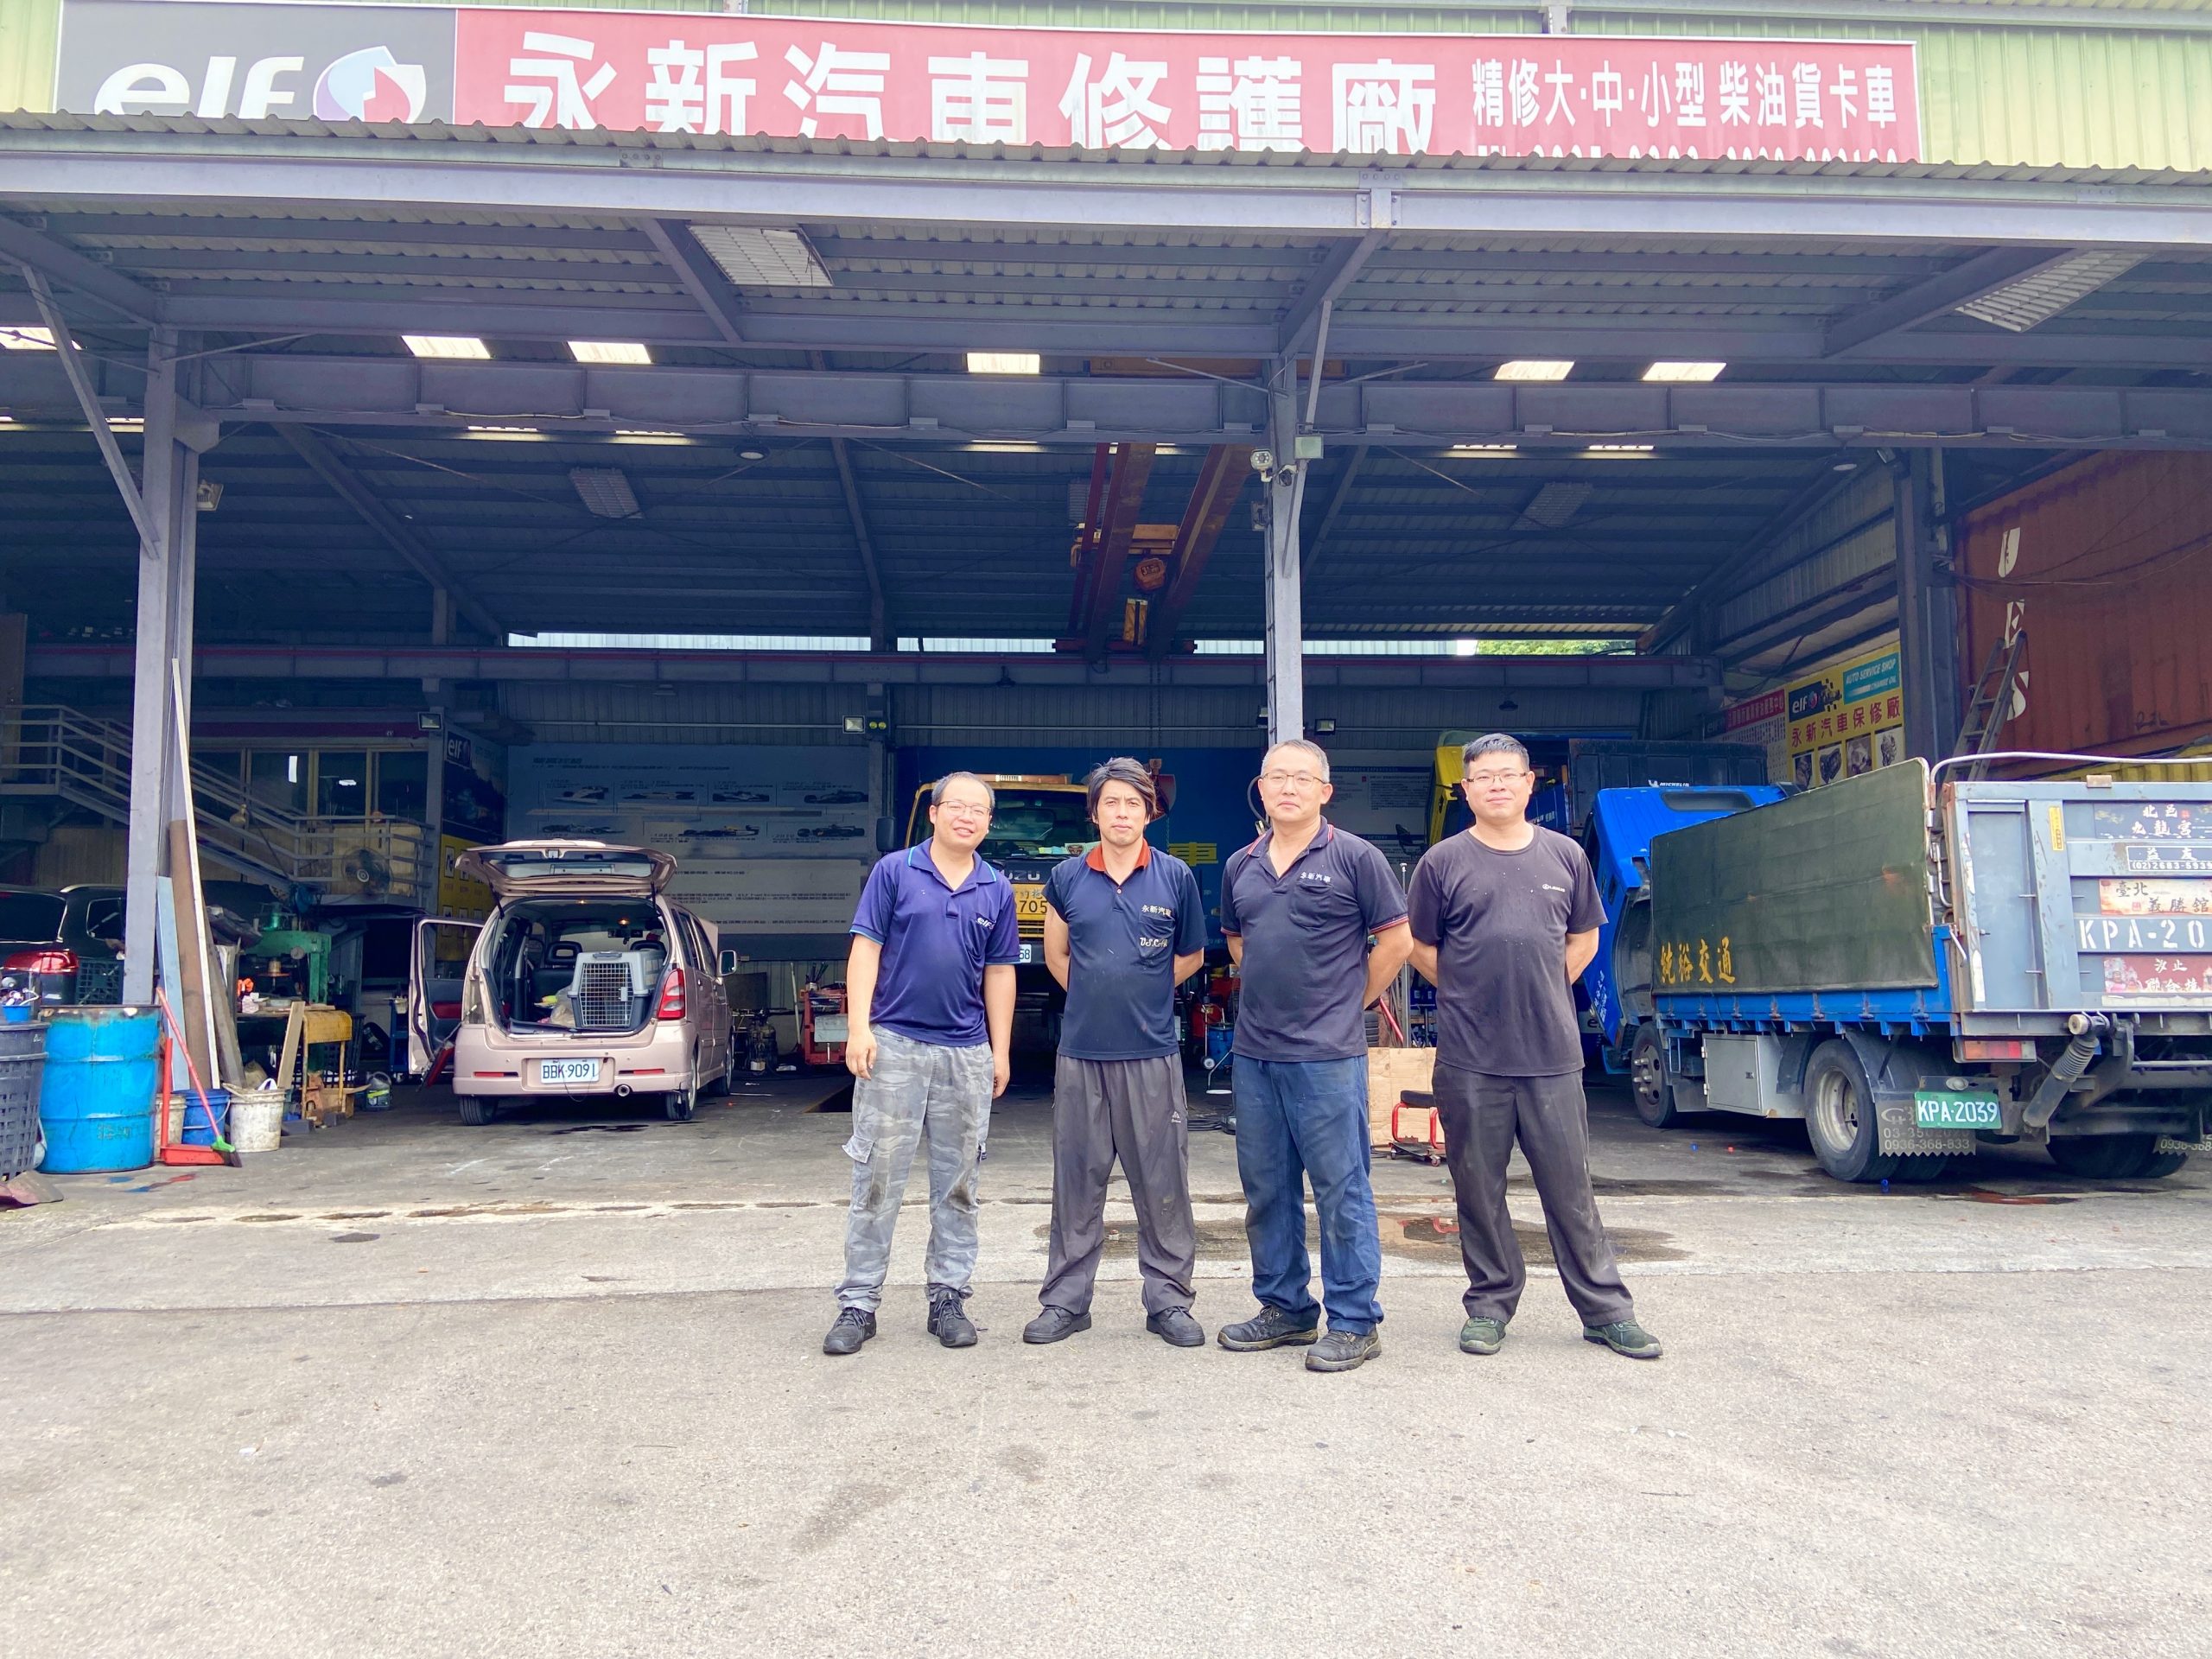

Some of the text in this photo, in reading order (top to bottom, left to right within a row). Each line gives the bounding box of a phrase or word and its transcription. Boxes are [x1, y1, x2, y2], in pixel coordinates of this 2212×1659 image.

[93, 55, 304, 118] elf
[504, 31, 1436, 154] 永新汽車修護廠
[1846, 658, 1897, 684] AUTO SERVICE SHOP
[1792, 696, 1808, 714] elf
[1791, 696, 1901, 748] 永新汽車保修廠
[448, 737, 461, 760] elf
[2132, 819, 2192, 838] 九龍宮
[1300, 871, 1332, 883] 永新汽車
[2116, 880, 2149, 898] 臺北
[1141, 904, 1172, 917] 永新汽車
[977, 917, 993, 927] elf
[1884, 1139, 1970, 1150] 0936-368-833
